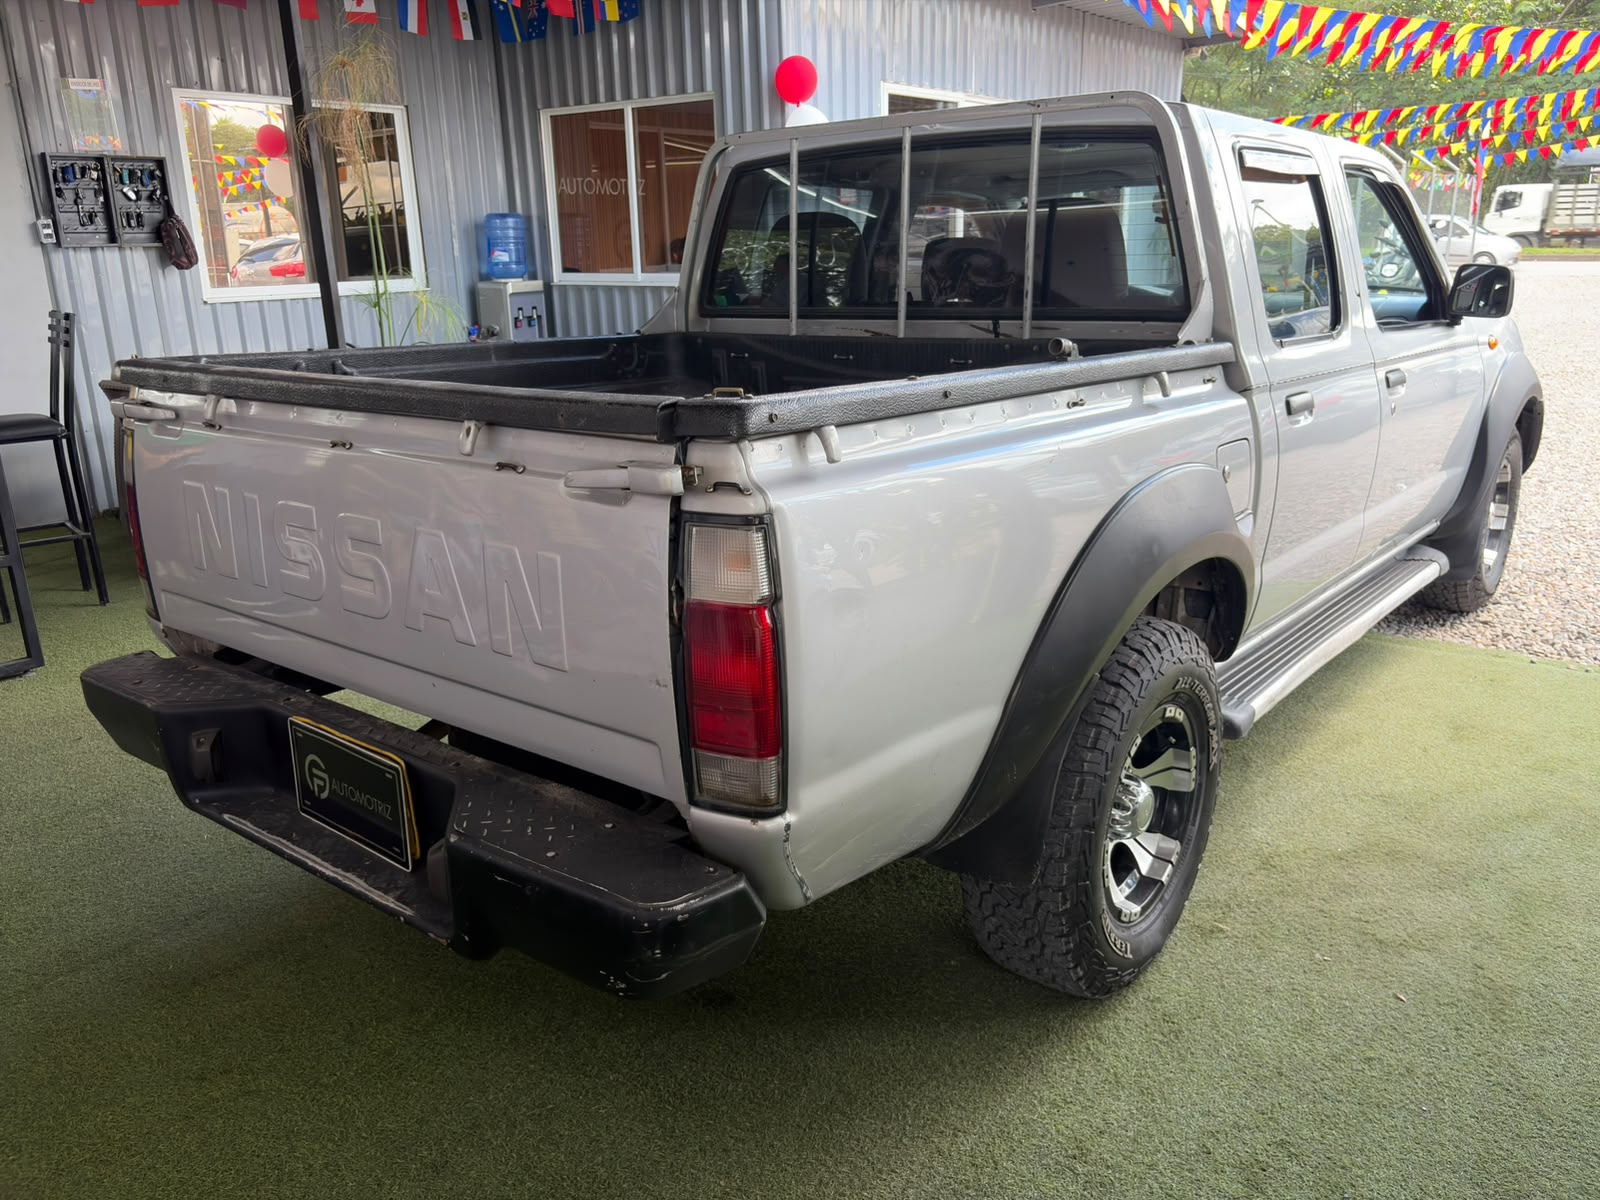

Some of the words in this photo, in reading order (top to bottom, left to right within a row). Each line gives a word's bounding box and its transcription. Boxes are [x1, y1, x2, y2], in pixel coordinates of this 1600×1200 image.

[558, 177, 646, 196] AUTOMOTZ
[183, 479, 569, 673] NISSAN
[331, 777, 393, 822] AUTOMOTRIZ
